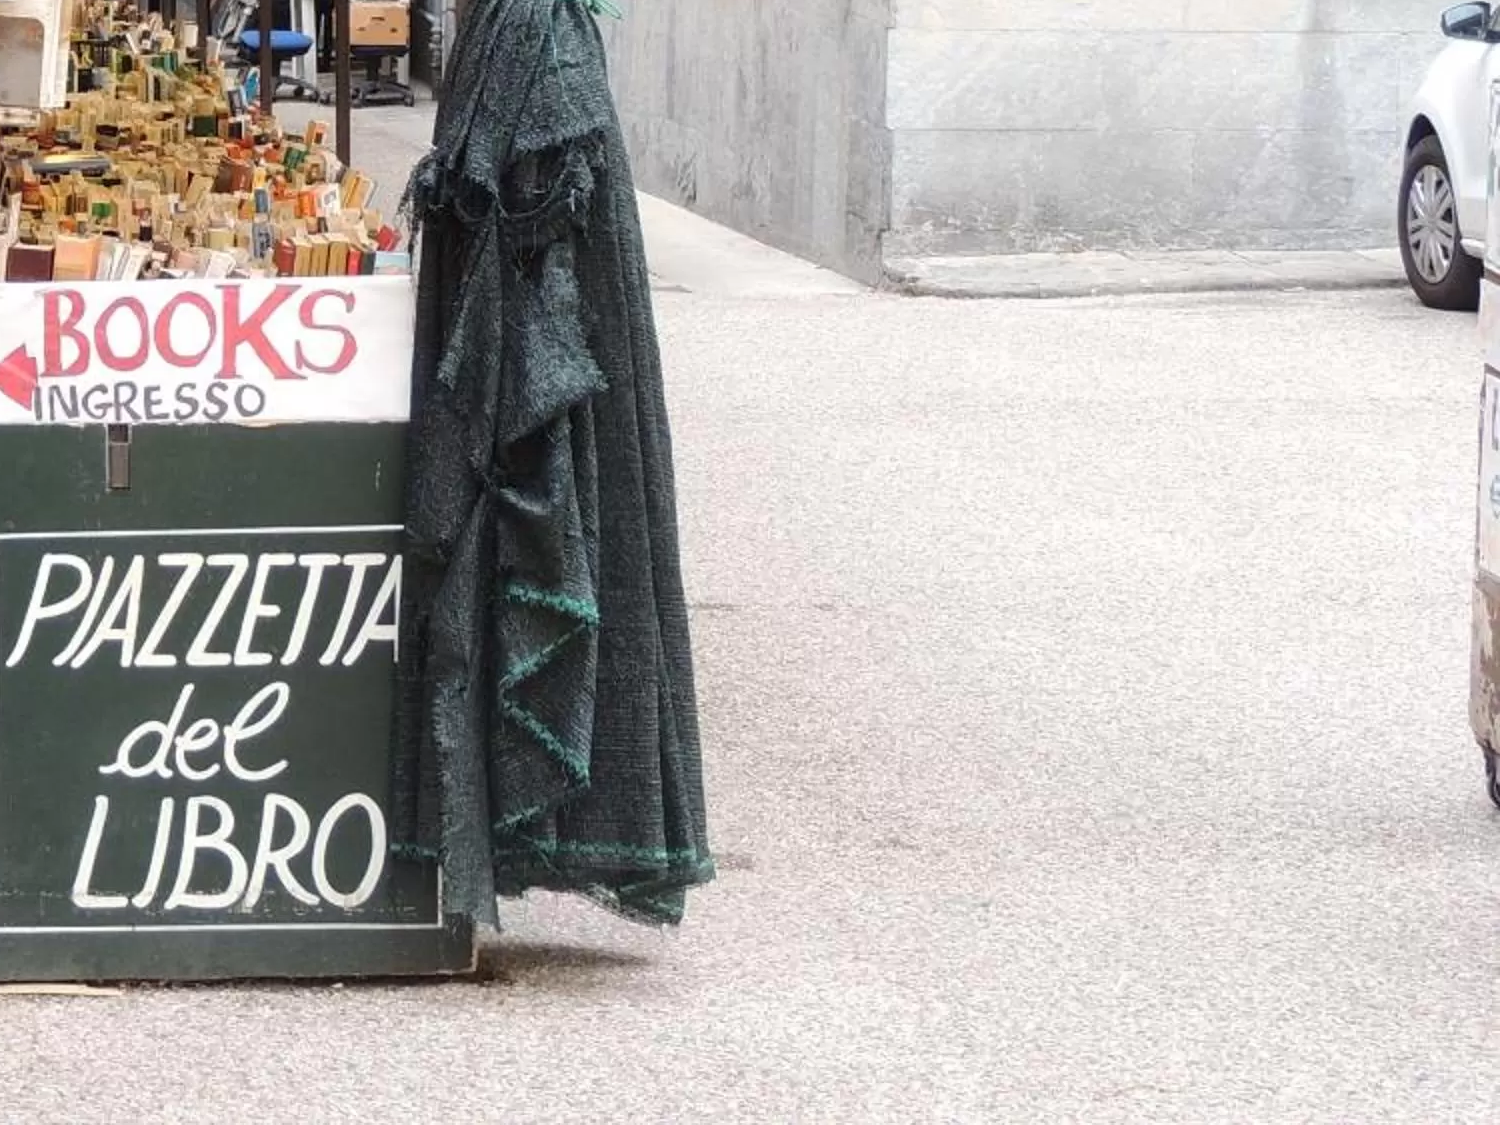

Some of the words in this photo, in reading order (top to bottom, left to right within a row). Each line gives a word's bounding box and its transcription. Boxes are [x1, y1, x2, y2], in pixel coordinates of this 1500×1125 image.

[41, 284, 358, 380] BOOKS
[32, 381, 268, 421] INGRESSO
[6, 552, 402, 669] PIAZZETTA
[99, 681, 291, 782] del
[70, 792, 388, 912] LIBRO
